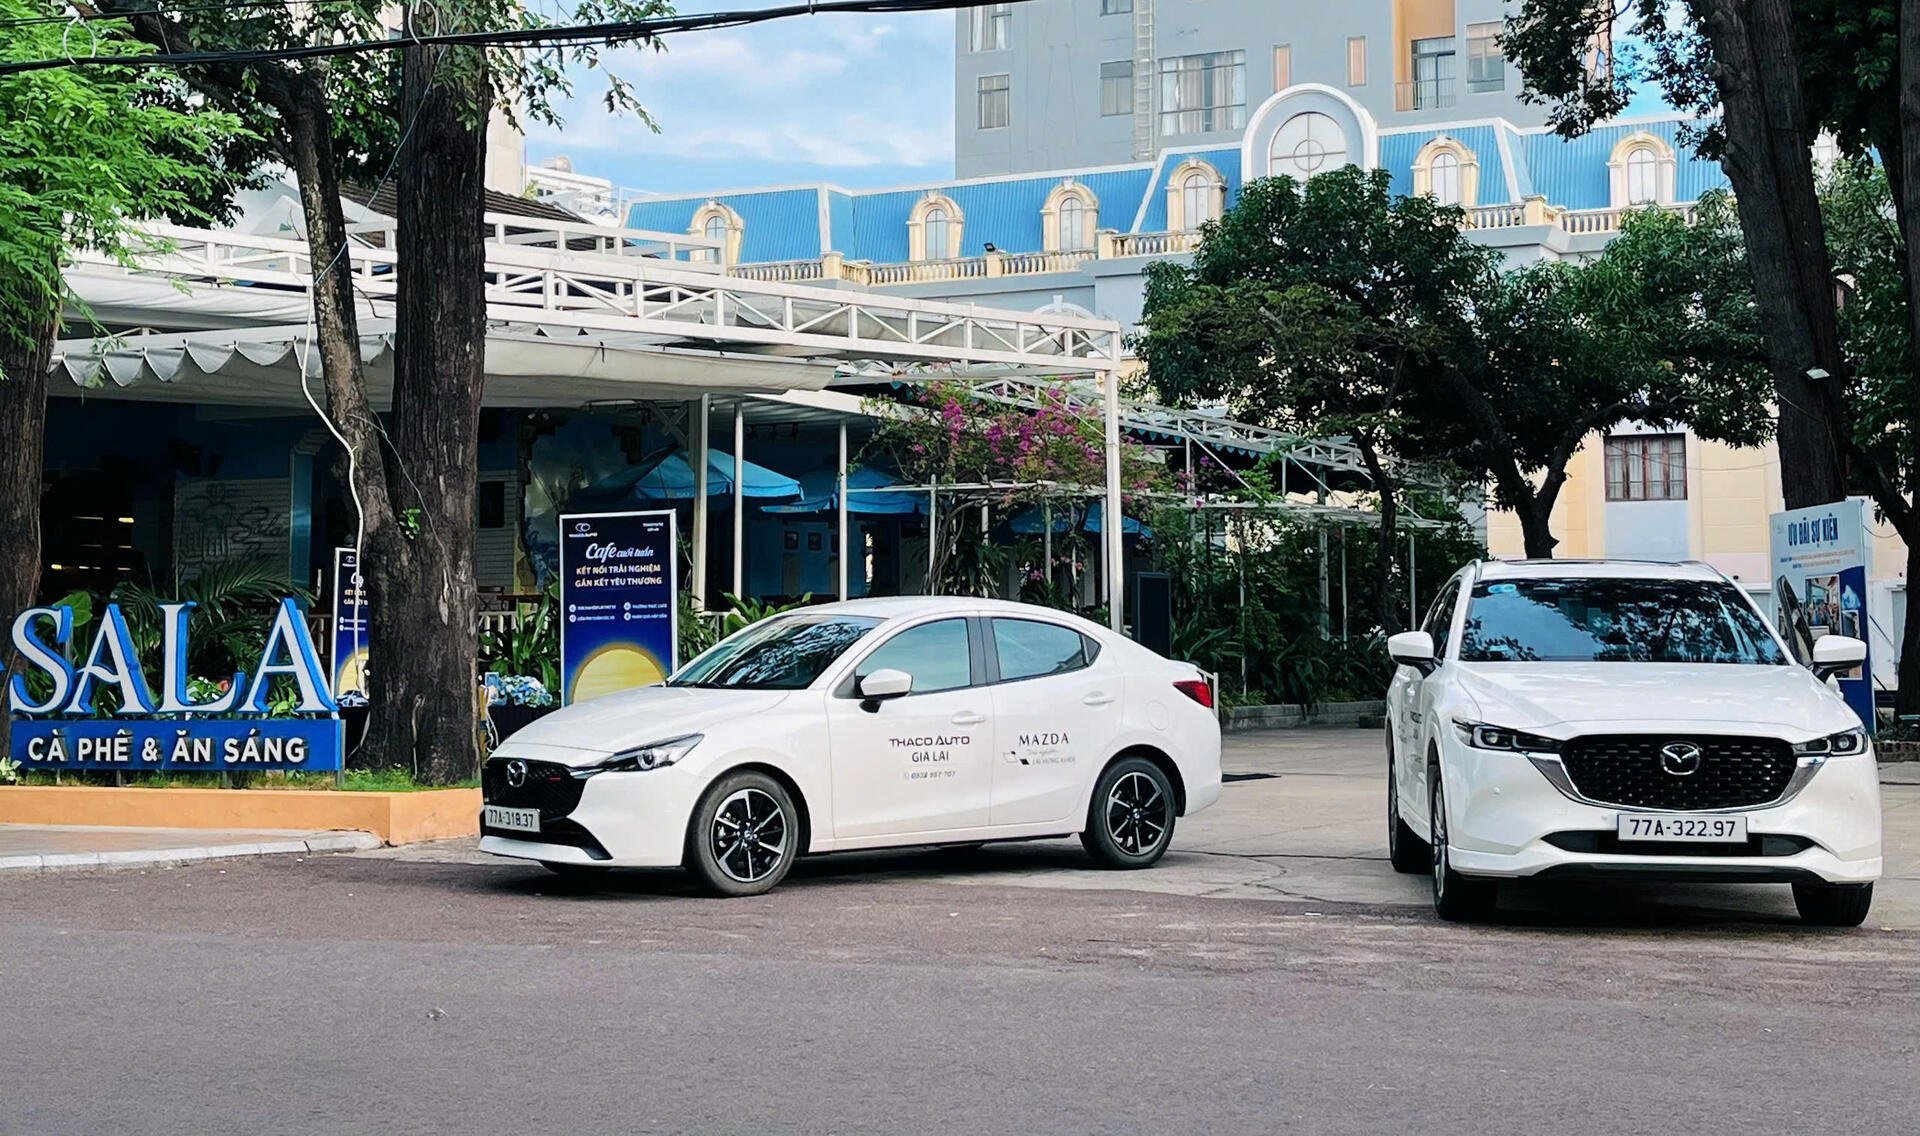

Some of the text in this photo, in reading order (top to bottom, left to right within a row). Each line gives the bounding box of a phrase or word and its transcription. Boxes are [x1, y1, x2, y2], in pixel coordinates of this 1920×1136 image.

[585, 542, 617, 563] Cafe
[9, 598, 338, 714] SALA
[28, 728, 306, 763] CÀ PHÊ & ĂN SÁNG
[889, 735, 970, 747] THACO AUTO
[1019, 732, 1069, 746] MAZDA
[912, 751, 949, 763] GIA LAI
[489, 809, 534, 828] 77A-318.37
[1629, 819, 1736, 837] 77A-322.97
